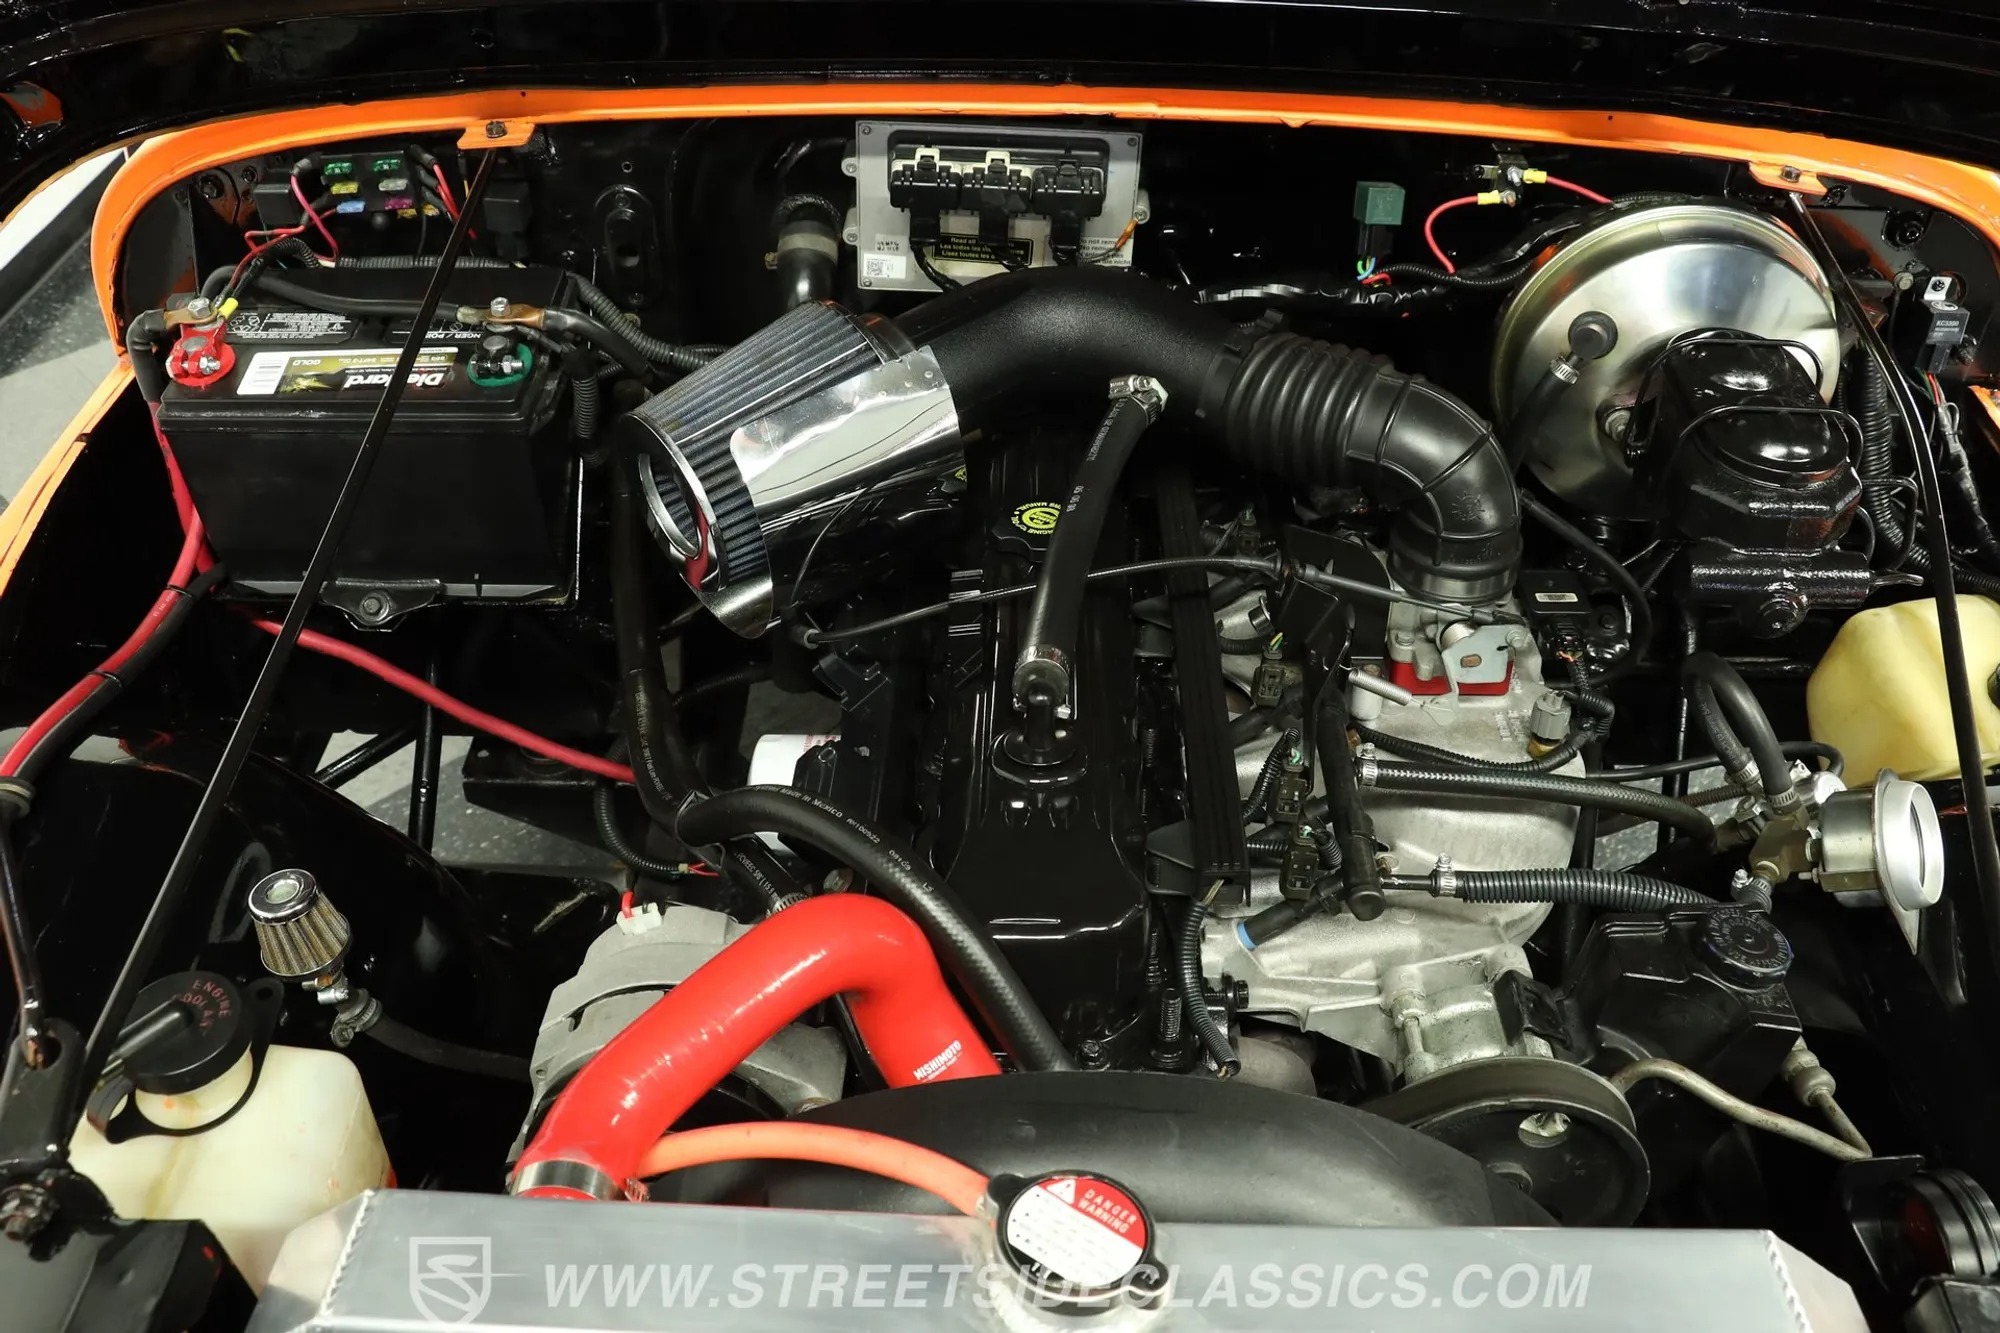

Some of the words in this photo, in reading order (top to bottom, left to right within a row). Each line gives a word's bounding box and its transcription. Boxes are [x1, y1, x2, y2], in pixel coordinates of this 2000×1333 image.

[292, 358, 321, 367] GOLD
[344, 371, 444, 388] Dieard
[811, 798, 843, 819] Mexico
[912, 1039, 962, 1081] MISHIMOTO
[1078, 1198, 1130, 1234] WARNING
[1084, 1188, 1137, 1225] DANGER
